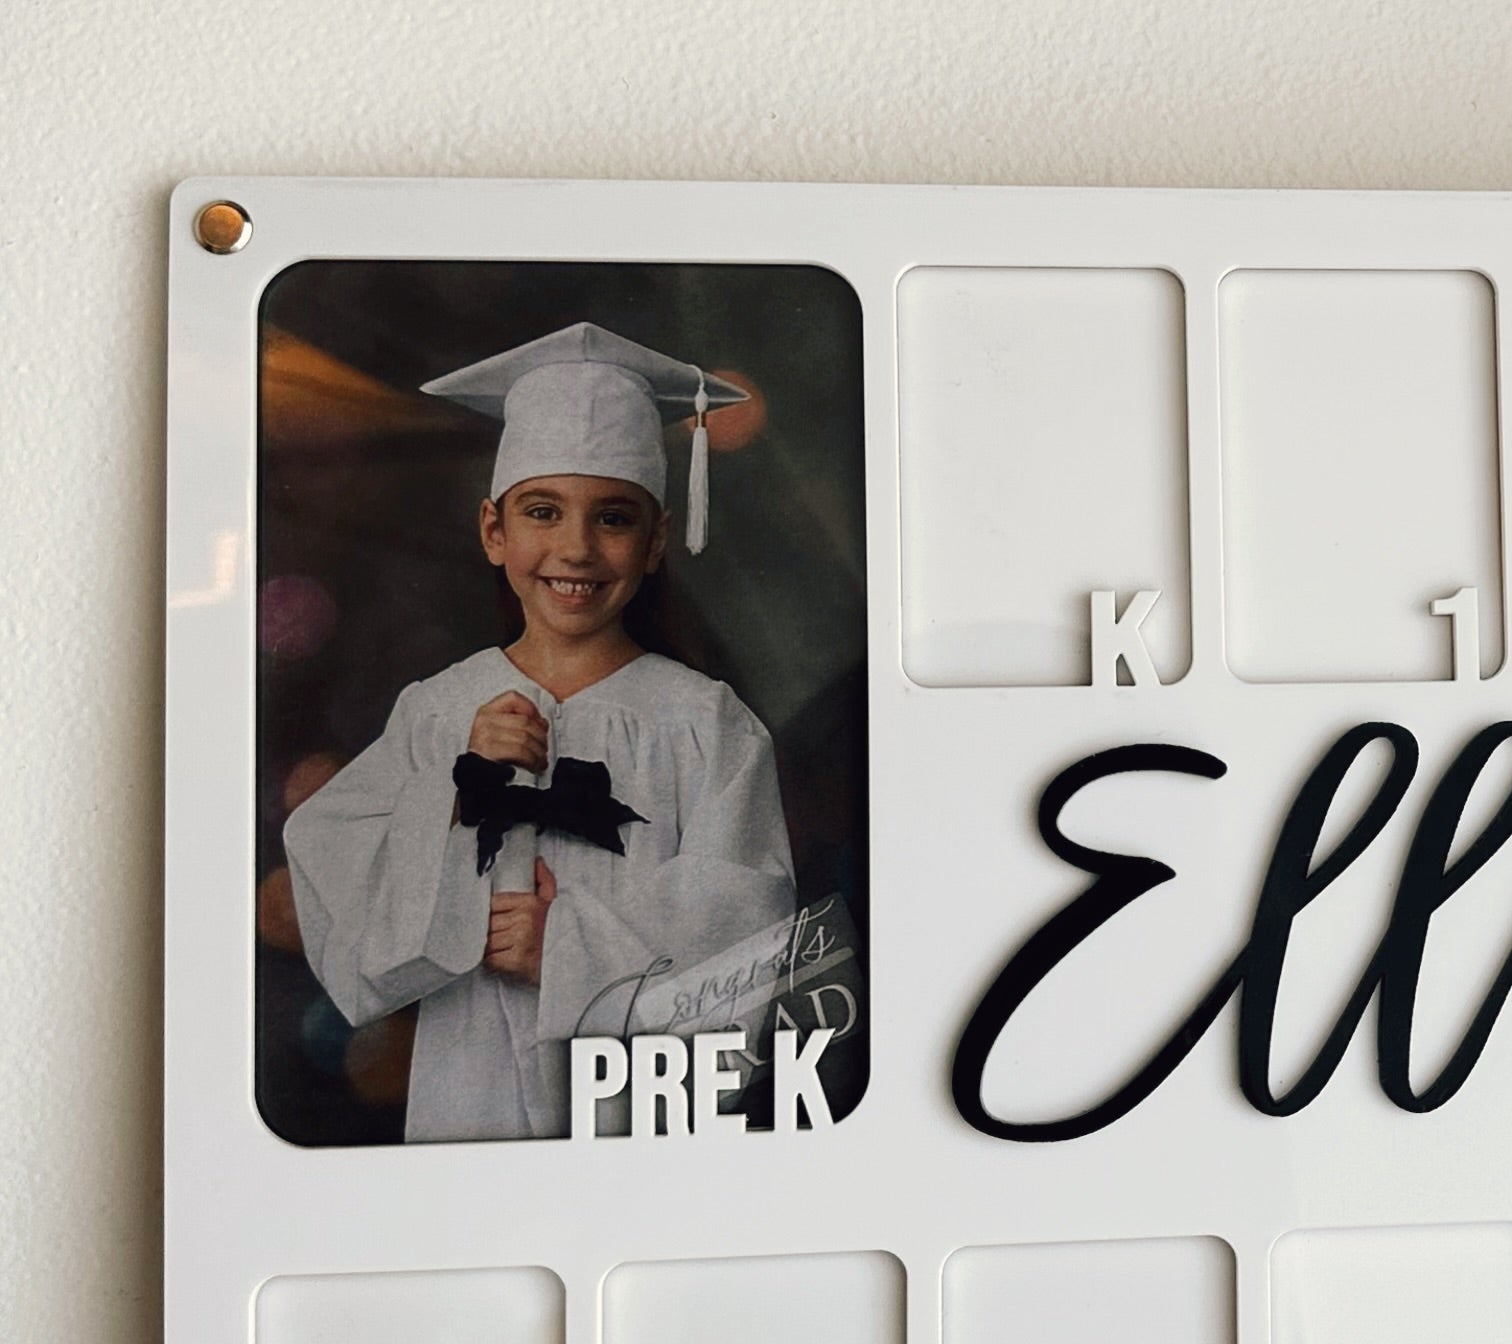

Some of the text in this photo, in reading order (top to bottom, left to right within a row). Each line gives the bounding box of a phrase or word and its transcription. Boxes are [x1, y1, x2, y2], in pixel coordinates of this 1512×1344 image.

[1089, 589, 1163, 686] K
[1429, 585, 1481, 681] 1
[570, 1027, 836, 1140] PRE K
